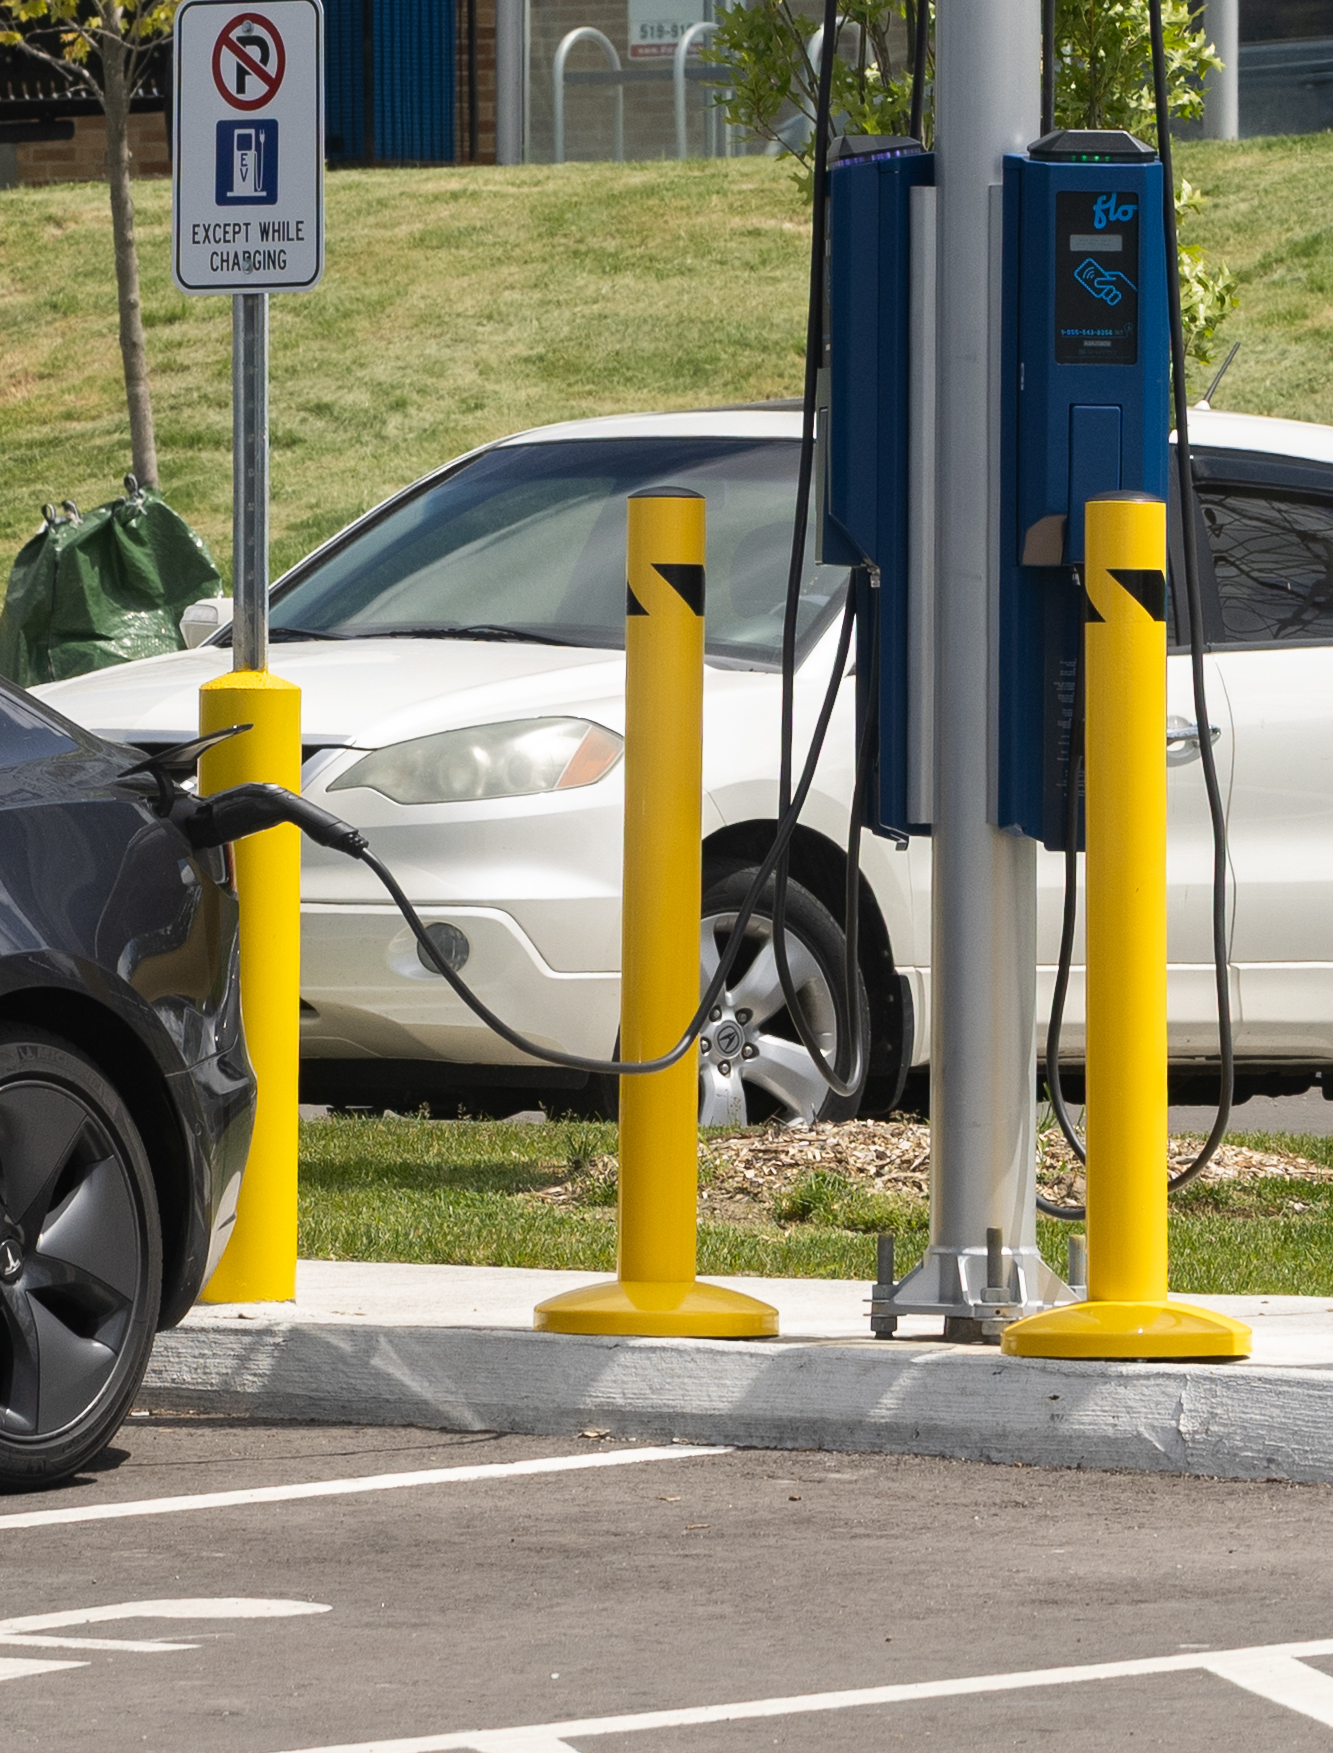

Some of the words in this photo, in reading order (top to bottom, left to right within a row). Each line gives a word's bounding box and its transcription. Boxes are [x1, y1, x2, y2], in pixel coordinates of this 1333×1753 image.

[1093, 192, 1138, 229] flo
[192, 222, 252, 245] EXCEPT
[259, 220, 305, 243] WHILE
[210, 249, 287, 272] CHARGING
